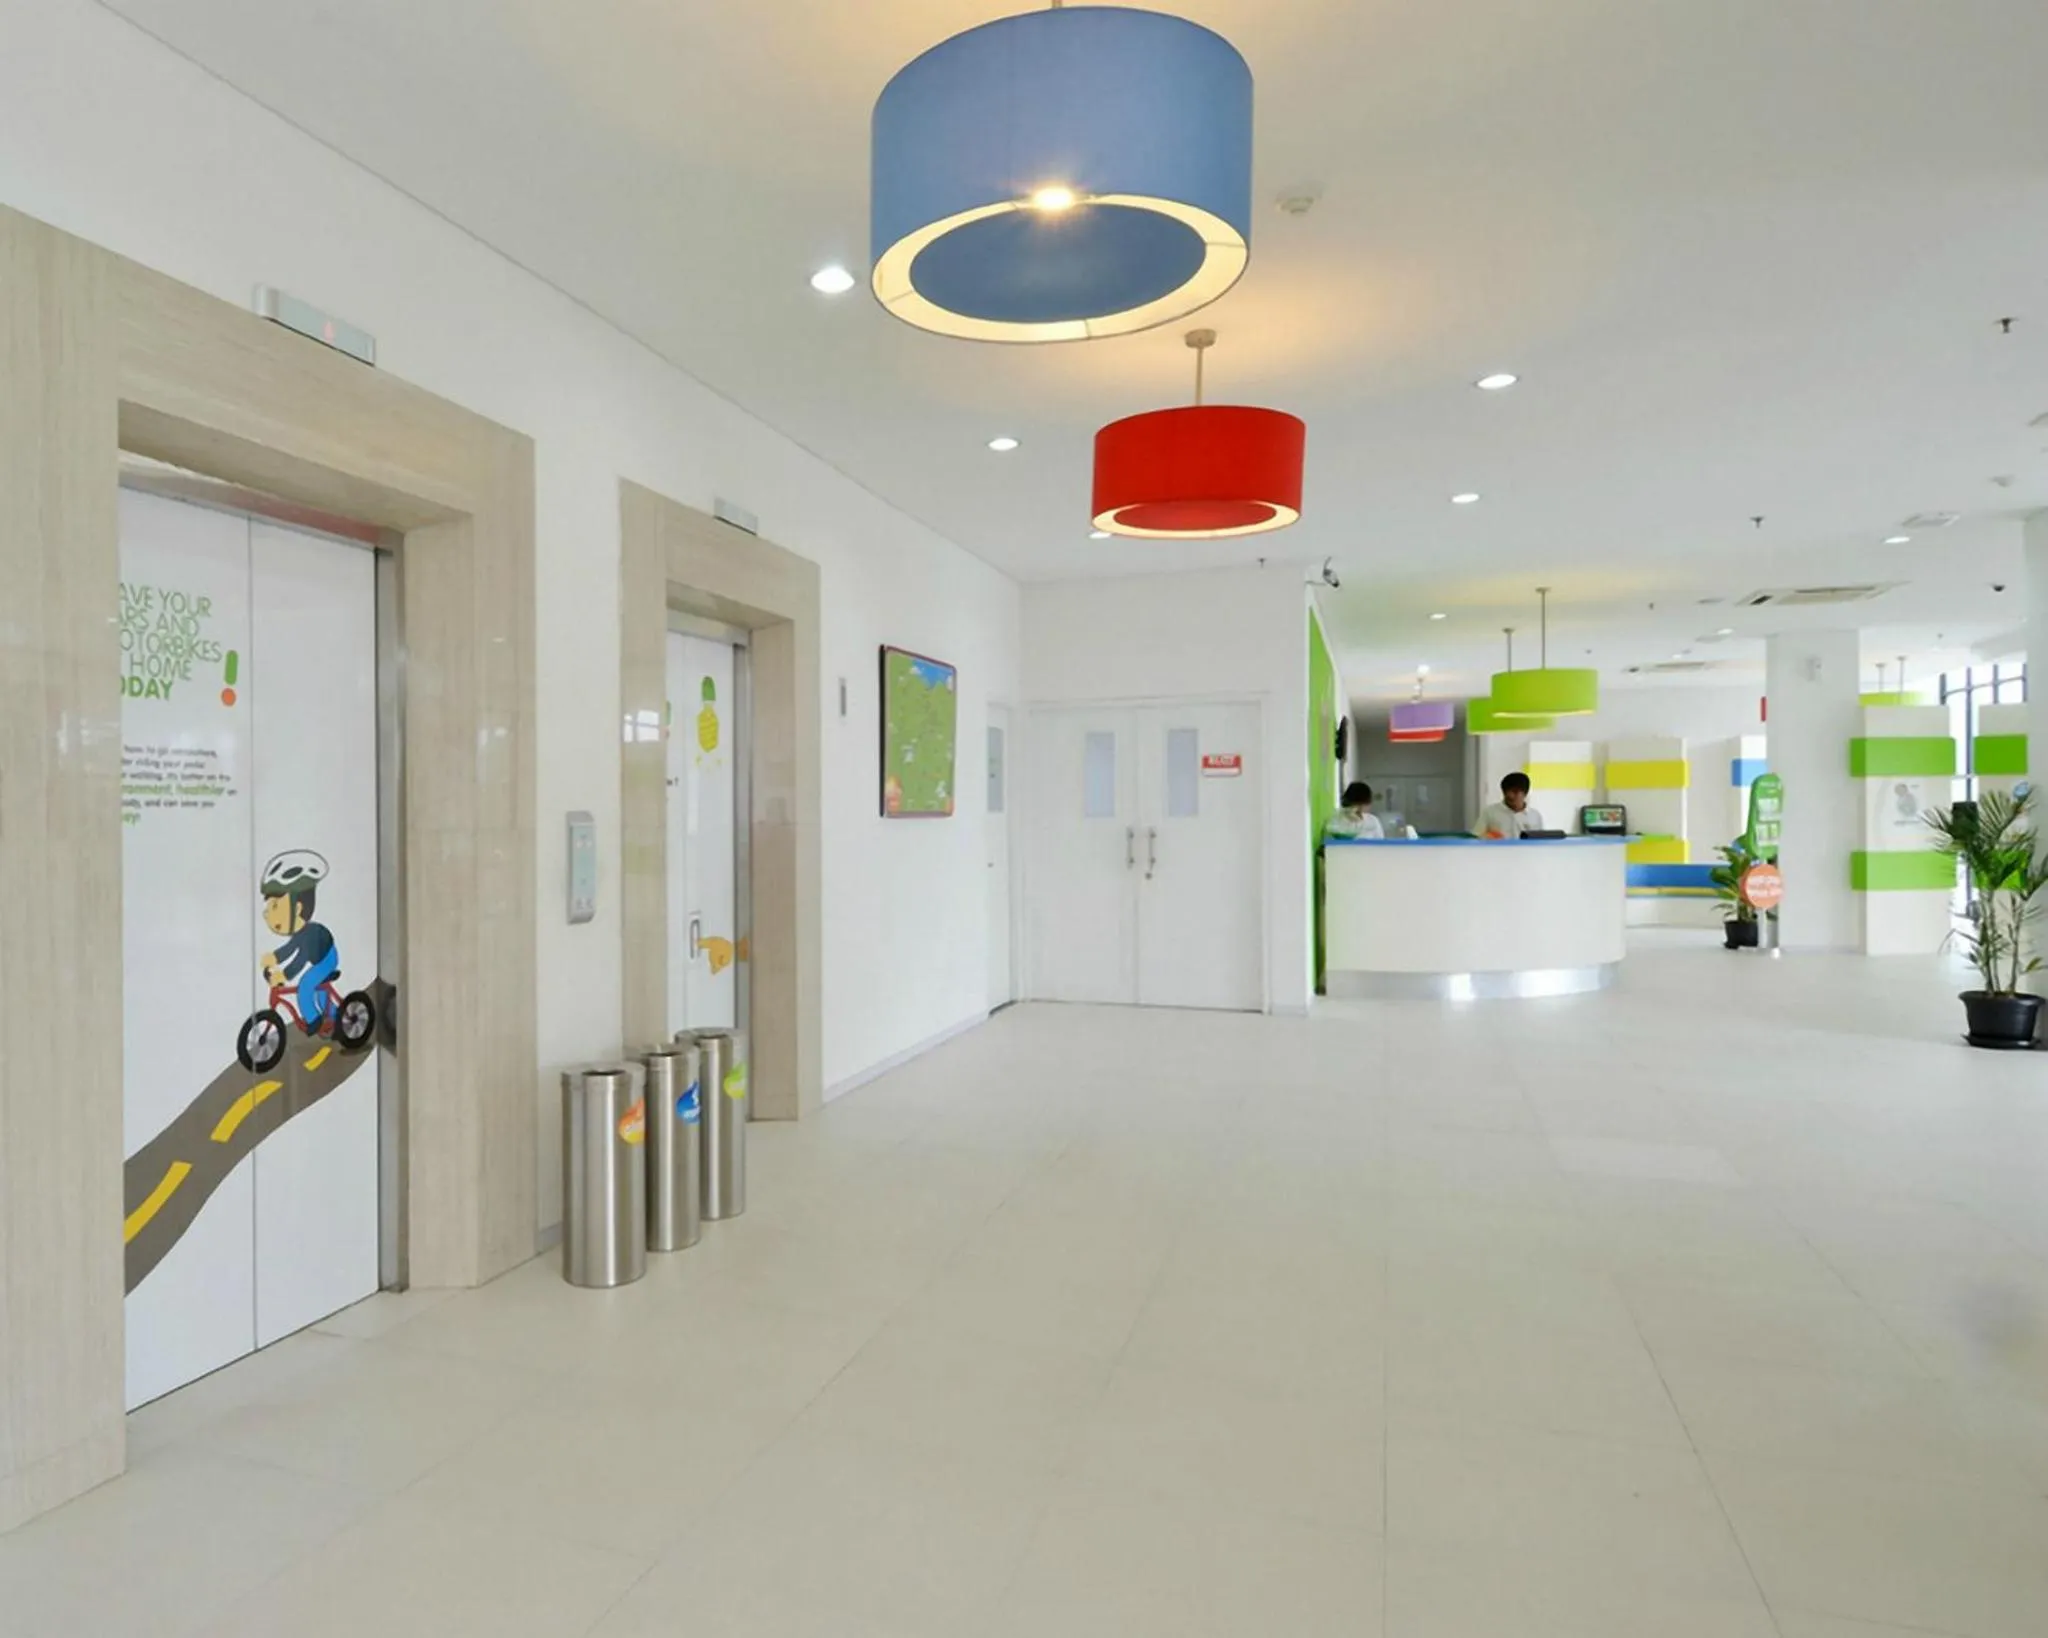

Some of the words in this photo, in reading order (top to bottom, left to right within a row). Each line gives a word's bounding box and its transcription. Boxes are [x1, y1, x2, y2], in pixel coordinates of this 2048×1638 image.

[158, 588, 212, 617] YOUR
[156, 613, 200, 637] AND
[130, 653, 192, 681] HOME
